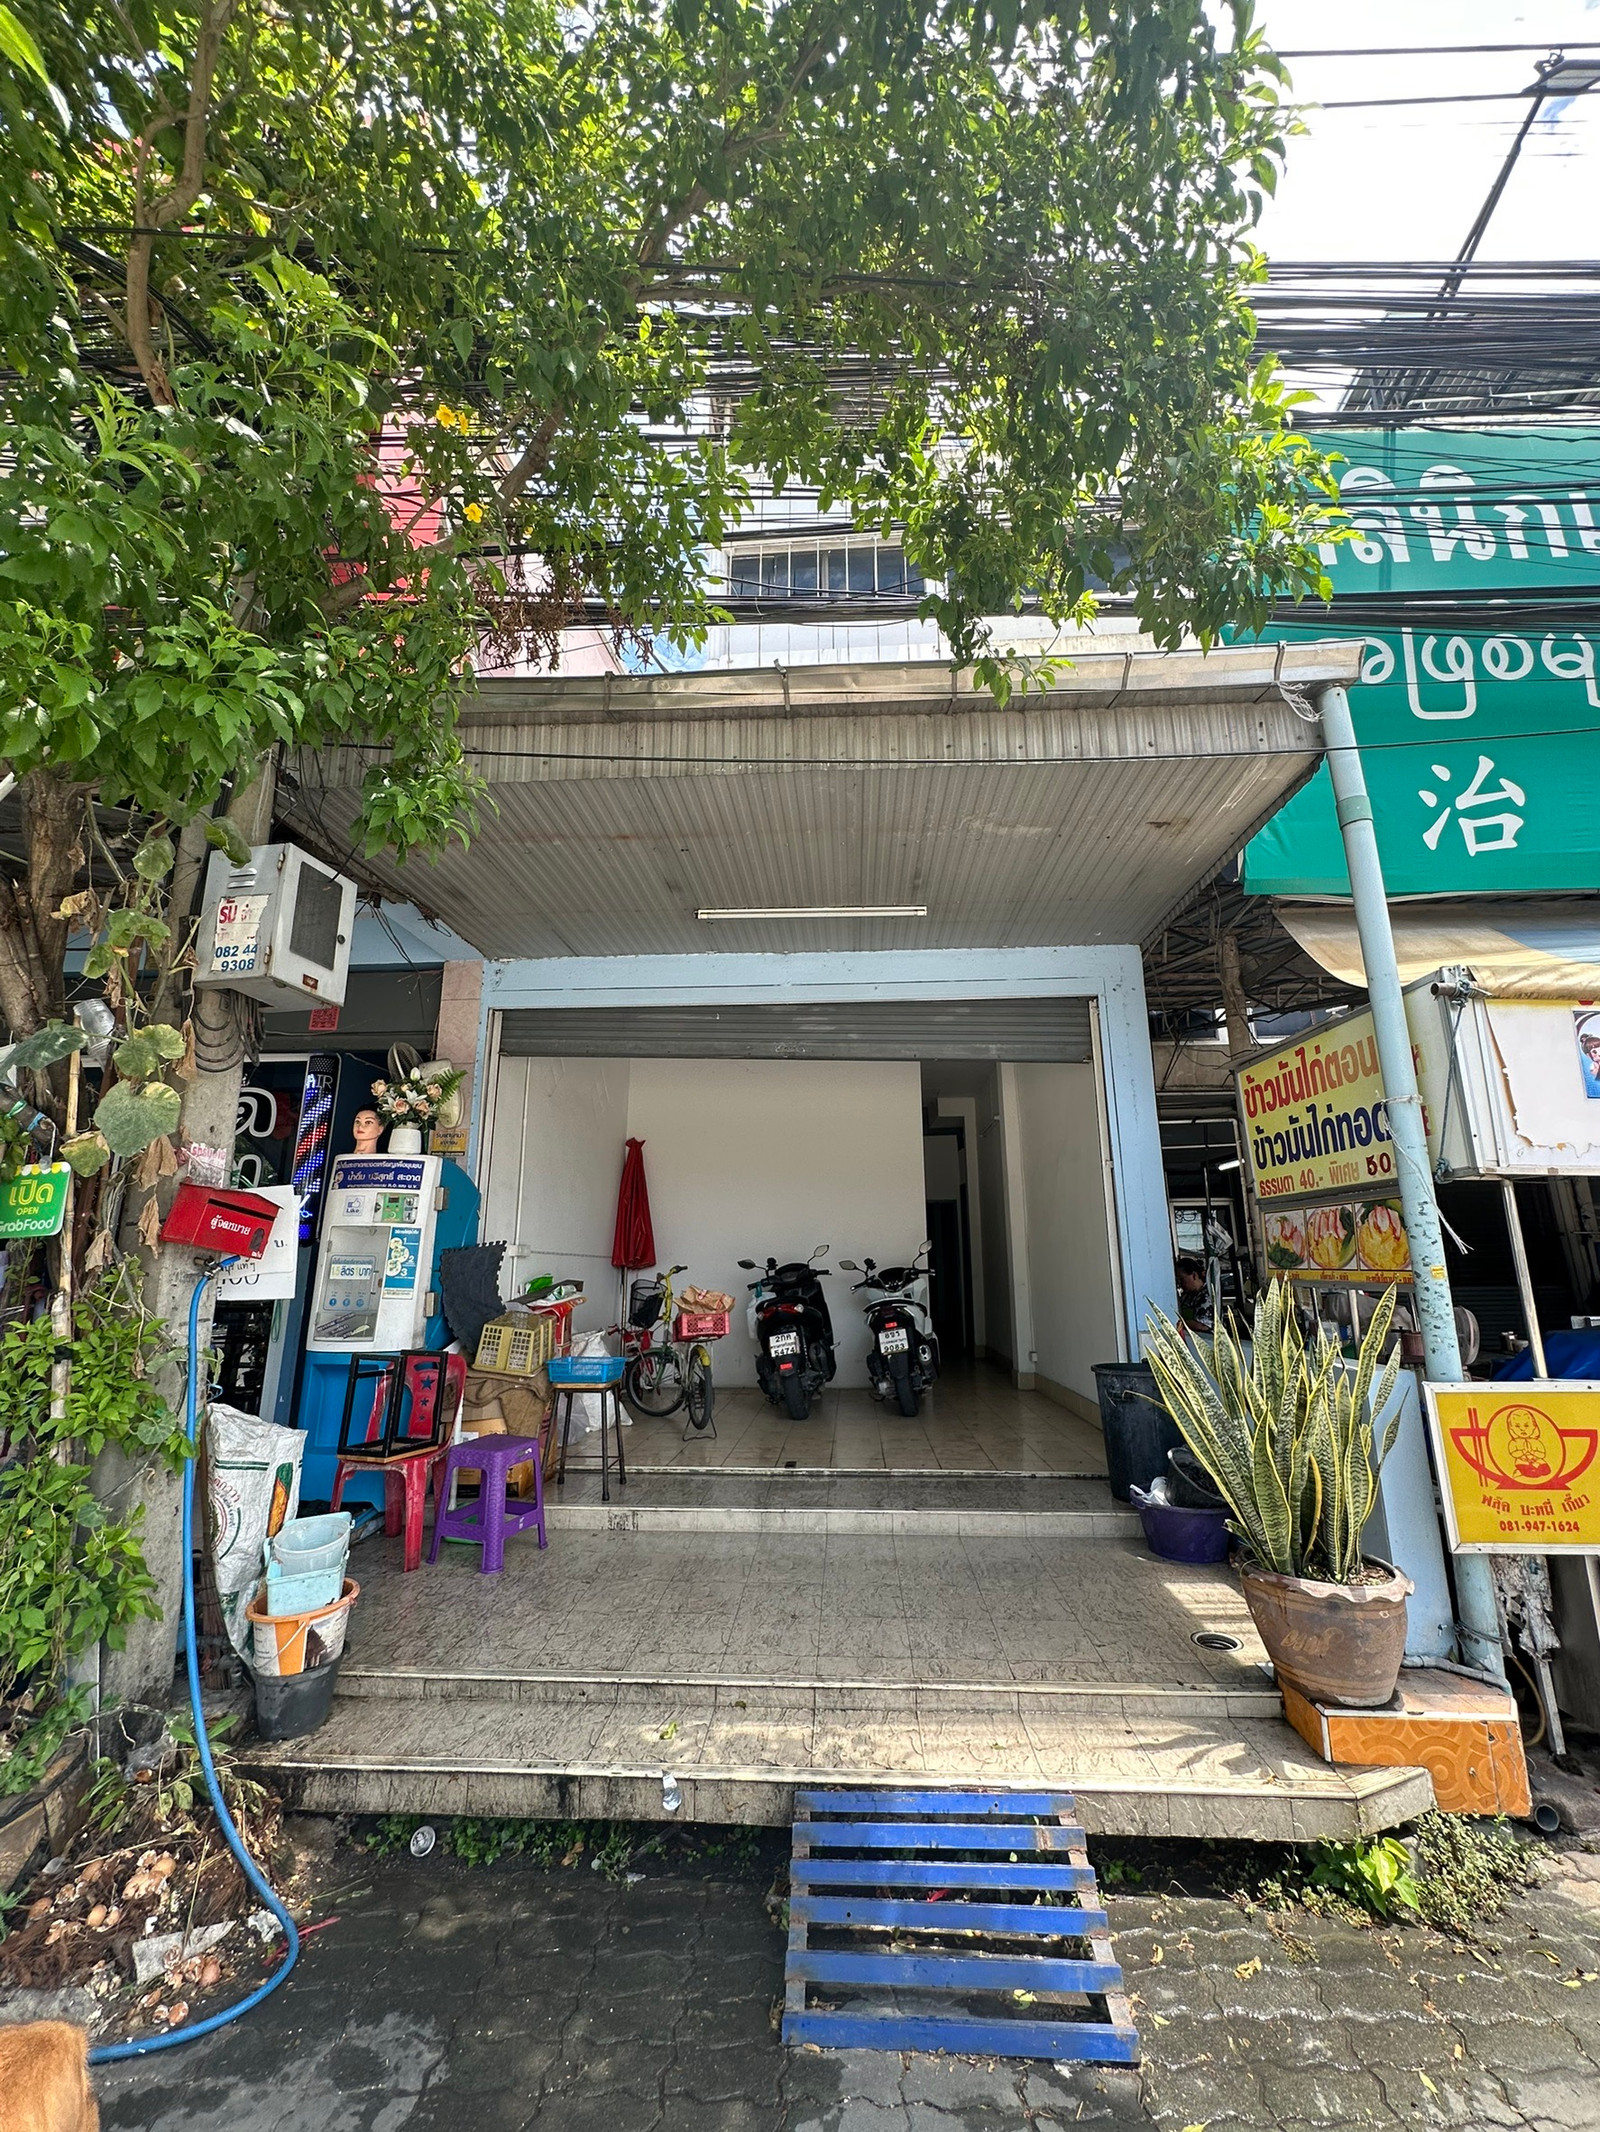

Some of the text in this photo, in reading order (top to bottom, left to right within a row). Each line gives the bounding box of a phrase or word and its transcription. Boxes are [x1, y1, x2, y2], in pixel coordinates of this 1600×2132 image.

[1417, 754, 1526, 858] 治
[215, 945, 240, 958] 082
[221, 958, 256, 972] 9308
[1243, 1034, 1380, 1119] ข้าวมันไก่ตอน
[9, 1179, 54, 1206] เปิด
[16, 1207, 40, 1216] OPEN
[1499, 1520, 1580, 1532] 081-947-1624
